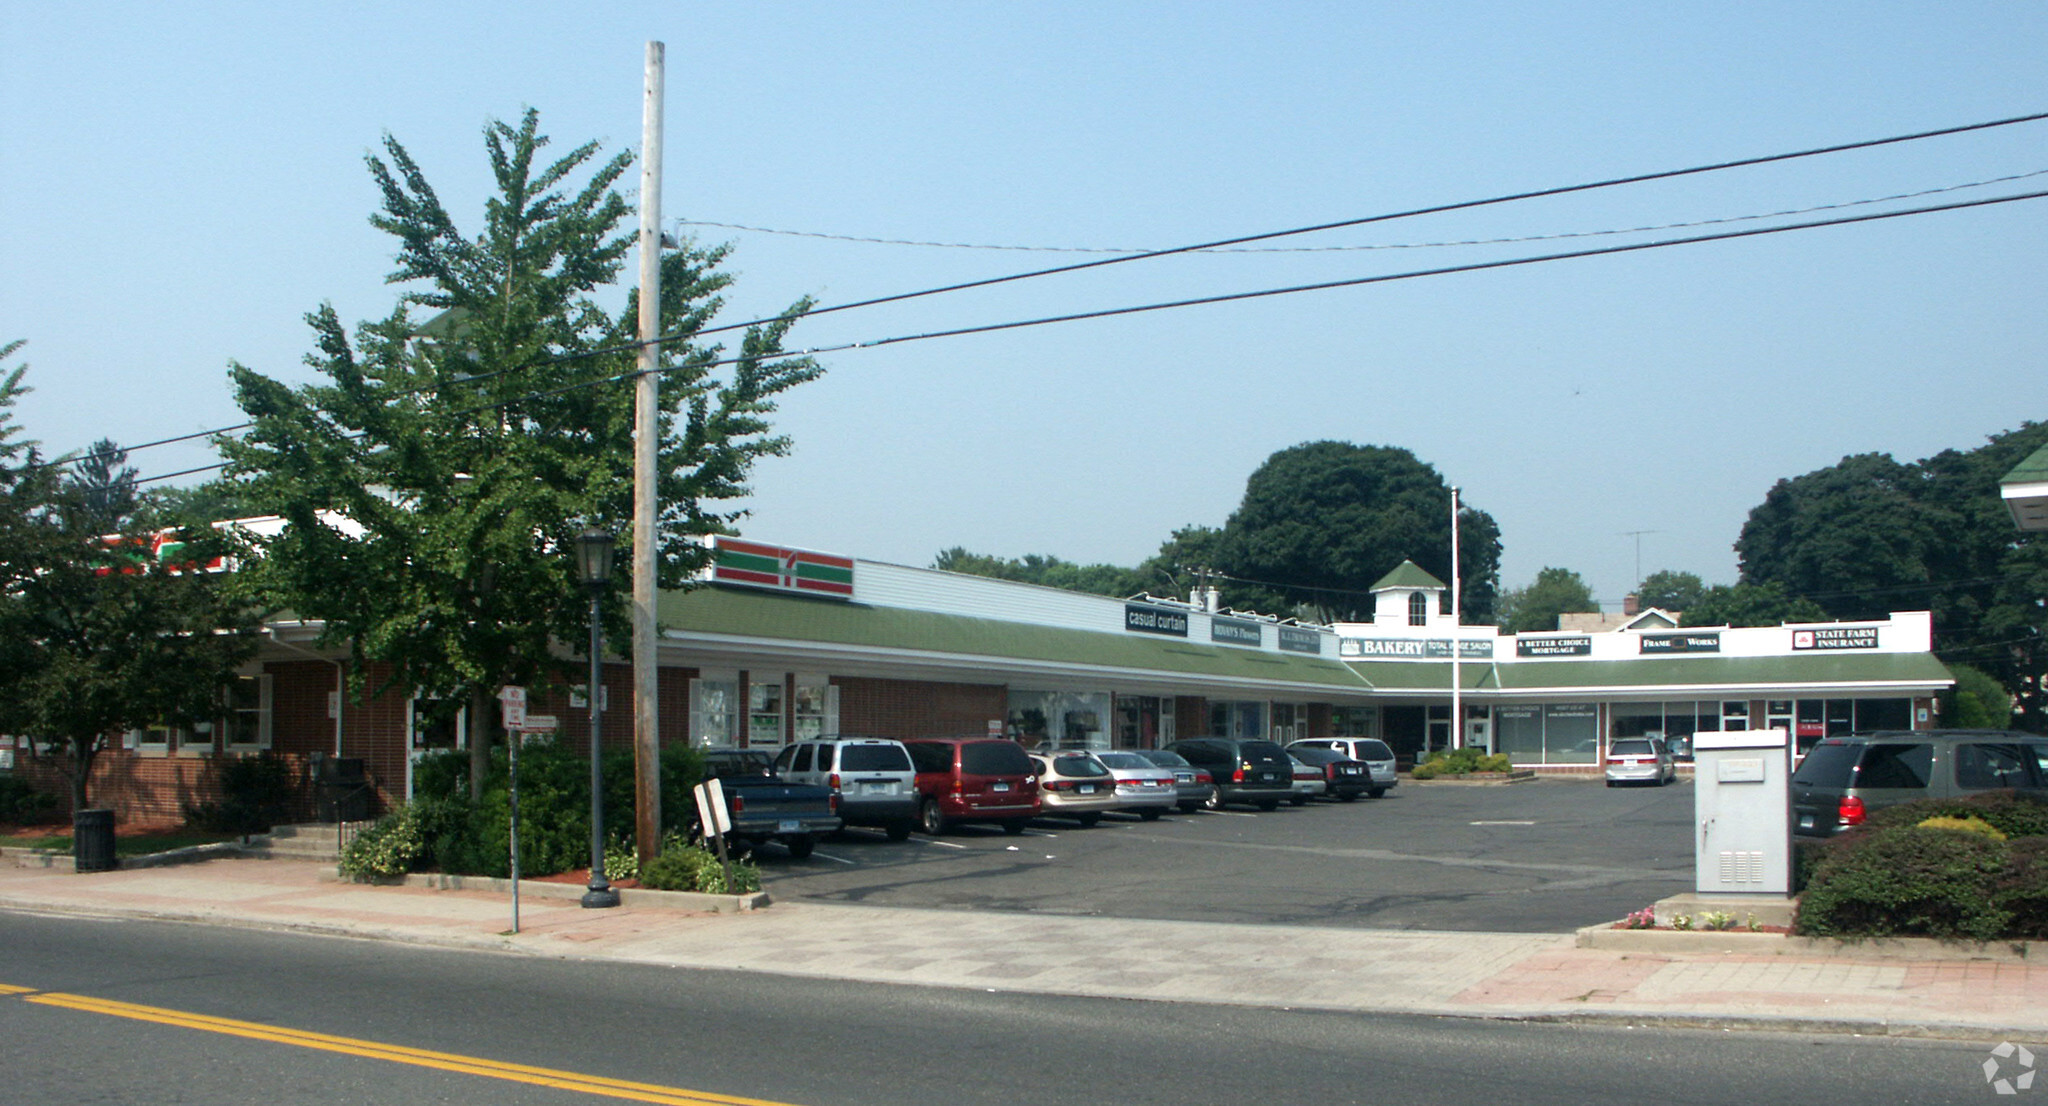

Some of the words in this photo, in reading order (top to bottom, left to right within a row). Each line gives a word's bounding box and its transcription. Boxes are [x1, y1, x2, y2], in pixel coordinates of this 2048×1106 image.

[1128, 610, 1157, 626] casual
[1157, 615, 1186, 631] curtain
[1815, 630, 1845, 639] STATE
[1847, 629, 1875, 638] FARM
[1363, 640, 1424, 655] BAKERY
[1427, 641, 1448, 650] TOTAL
[1470, 641, 1492, 651] SALON
[1558, 639, 1590, 647] CHOICE
[1643, 639, 1671, 648] FRAME
[1687, 637, 1718, 646] WORKS
[1818, 638, 1874, 648] INSURANCE
[1531, 647, 1576, 655] MORTGAGE
